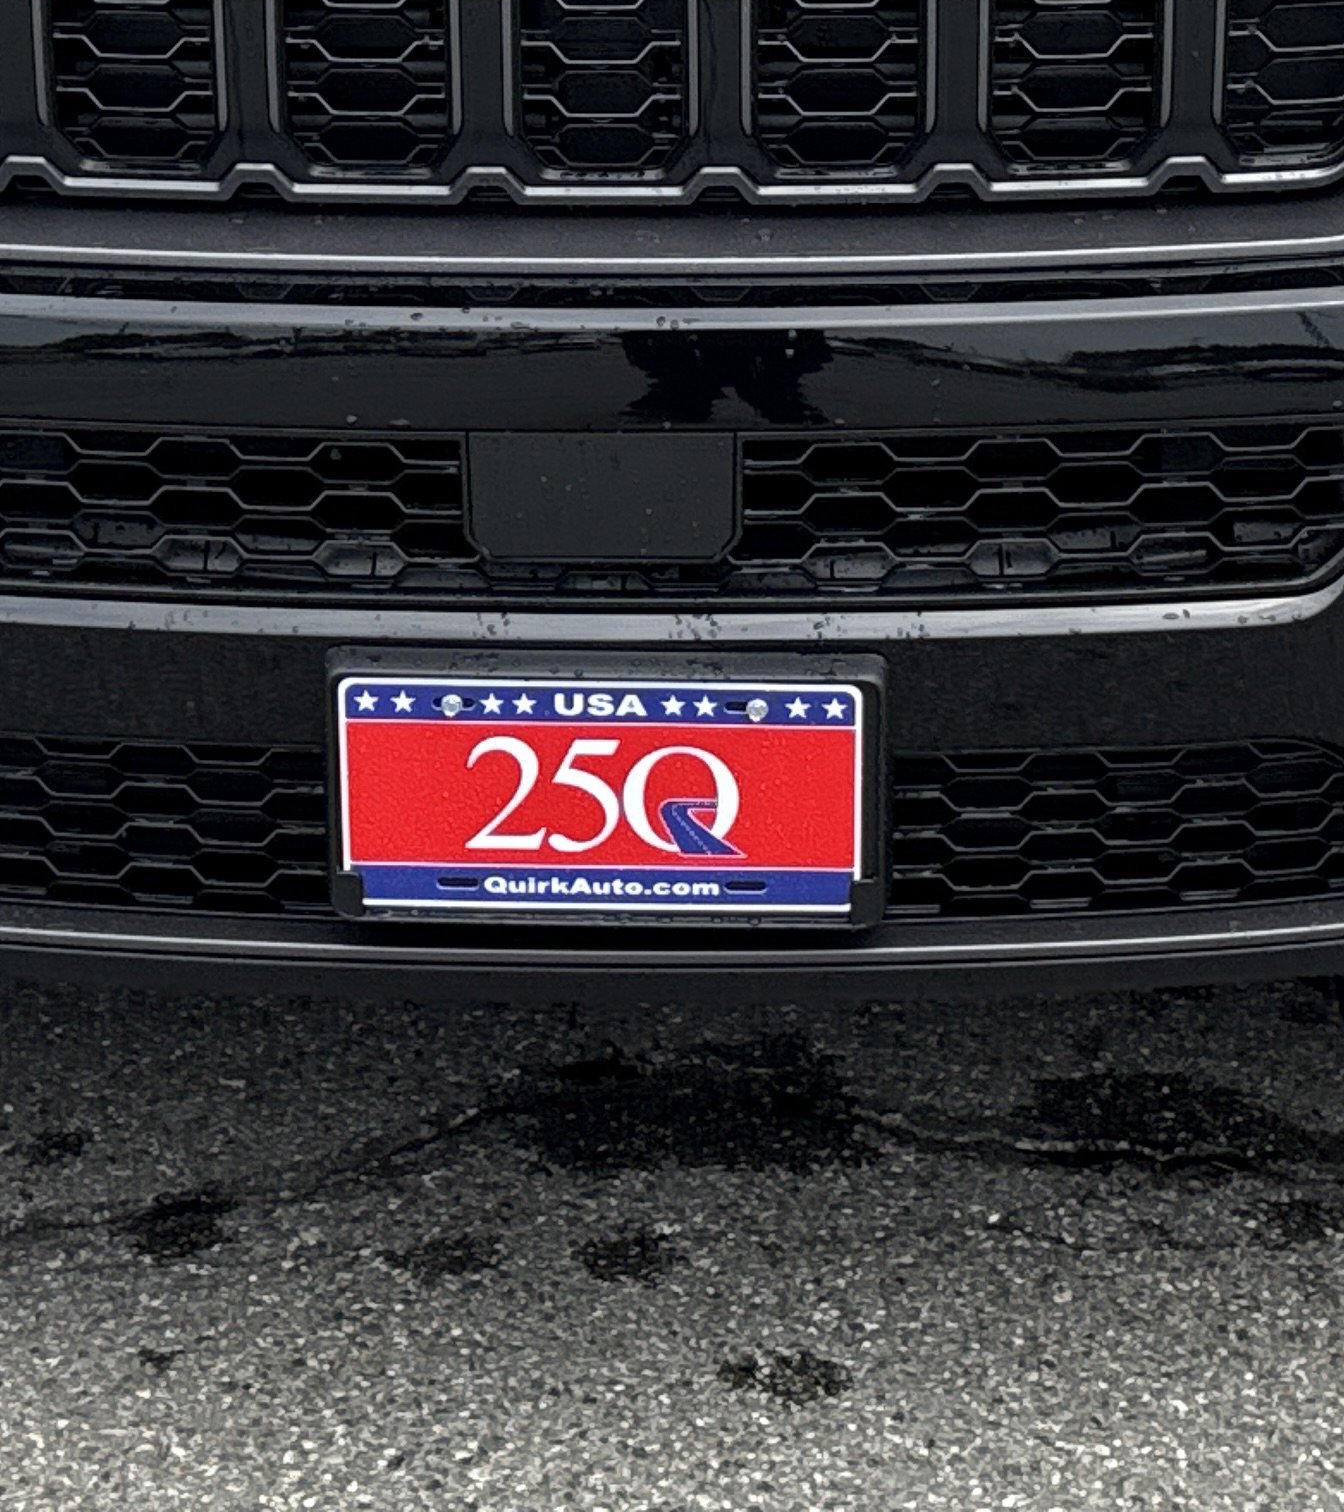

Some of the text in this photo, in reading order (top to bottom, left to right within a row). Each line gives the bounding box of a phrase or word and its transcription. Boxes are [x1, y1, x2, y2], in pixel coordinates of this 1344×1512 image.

[553, 692, 647, 717] USA
[465, 735, 747, 858] 25Q
[483, 875, 721, 897] QuirkAuto.com
